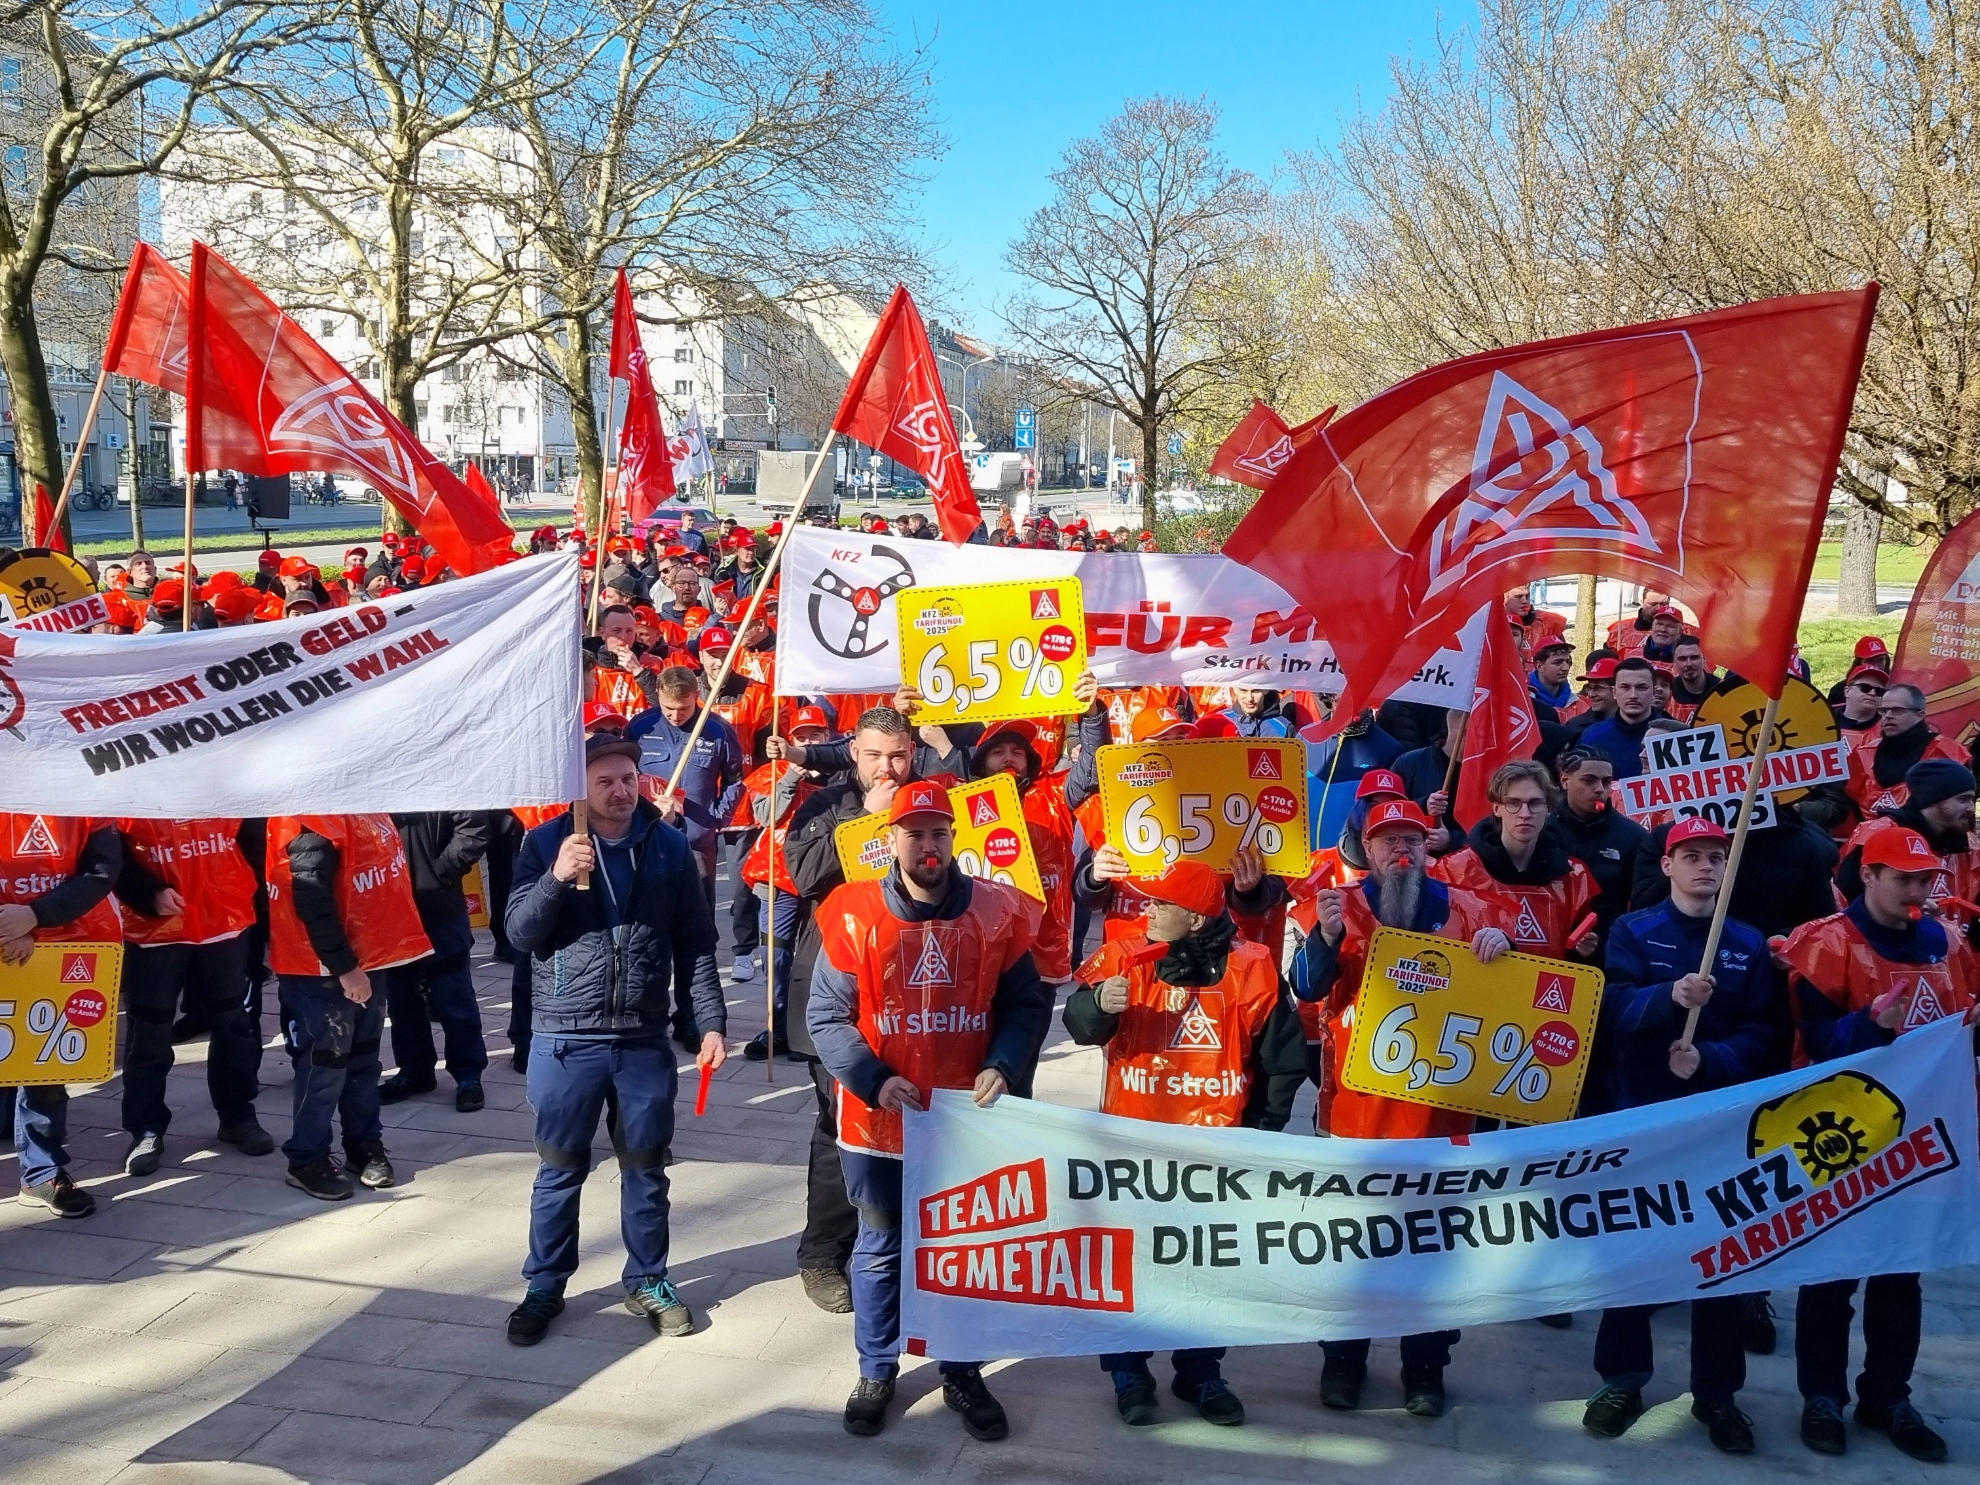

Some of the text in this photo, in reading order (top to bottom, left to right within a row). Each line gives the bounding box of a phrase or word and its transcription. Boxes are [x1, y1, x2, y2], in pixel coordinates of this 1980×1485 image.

[831, 548, 862, 564] KFZ
[31, 593, 51, 608] HU
[915, 617, 962, 627] TARIFRUNDE
[1936, 610, 1958, 620] Mit
[926, 627, 947, 635] 2025
[1086, 600, 1234, 658] FÜR
[1931, 633, 1948, 644] ist
[1203, 654, 1272, 671] Stark
[1280, 653, 1311, 673] im
[1929, 646, 1958, 658] dich
[60, 673, 207, 733] FREIZEIT
[205, 641, 302, 693] ODER
[300, 605, 388, 656] GELD
[919, 639, 1002, 713] 6,5
[81, 627, 452, 776] WIR WOLLEN DIE WAHL
[1651, 731, 1719, 770] KFZ
[1118, 771, 1172, 780] TARIFRUNDE
[1131, 779, 1154, 787] 2025
[1125, 793, 1216, 863] 6,5
[859, 846, 892, 863] TARIFRU
[864, 840, 880, 851] KFZ
[872, 856, 892, 868] 2025
[353, 866, 386, 894] Wir
[1399, 960, 1419, 971] KFZ
[1723, 961, 1747, 970] Service
[1389, 968, 1448, 988] TARIFRUNDE
[1398, 981, 1424, 993] 2025
[28, 998, 87, 1062] %
[1372, 1003, 1551, 1101] 6,5 %
[1121, 1066, 1246, 1097] Wir streik
[1816, 1134, 1848, 1160] HU
[1067, 1147, 1630, 1202] DRUCK MACHEN FÜR
[926, 1170, 1035, 1231] TEAM
[1691, 1124, 1946, 1279] TARIFRUNDE
[1706, 1153, 1804, 1229] KFZ
[1153, 1179, 1695, 1267] DIE FORDERUNGEN!
[964, 1233, 1124, 1304] METALL
